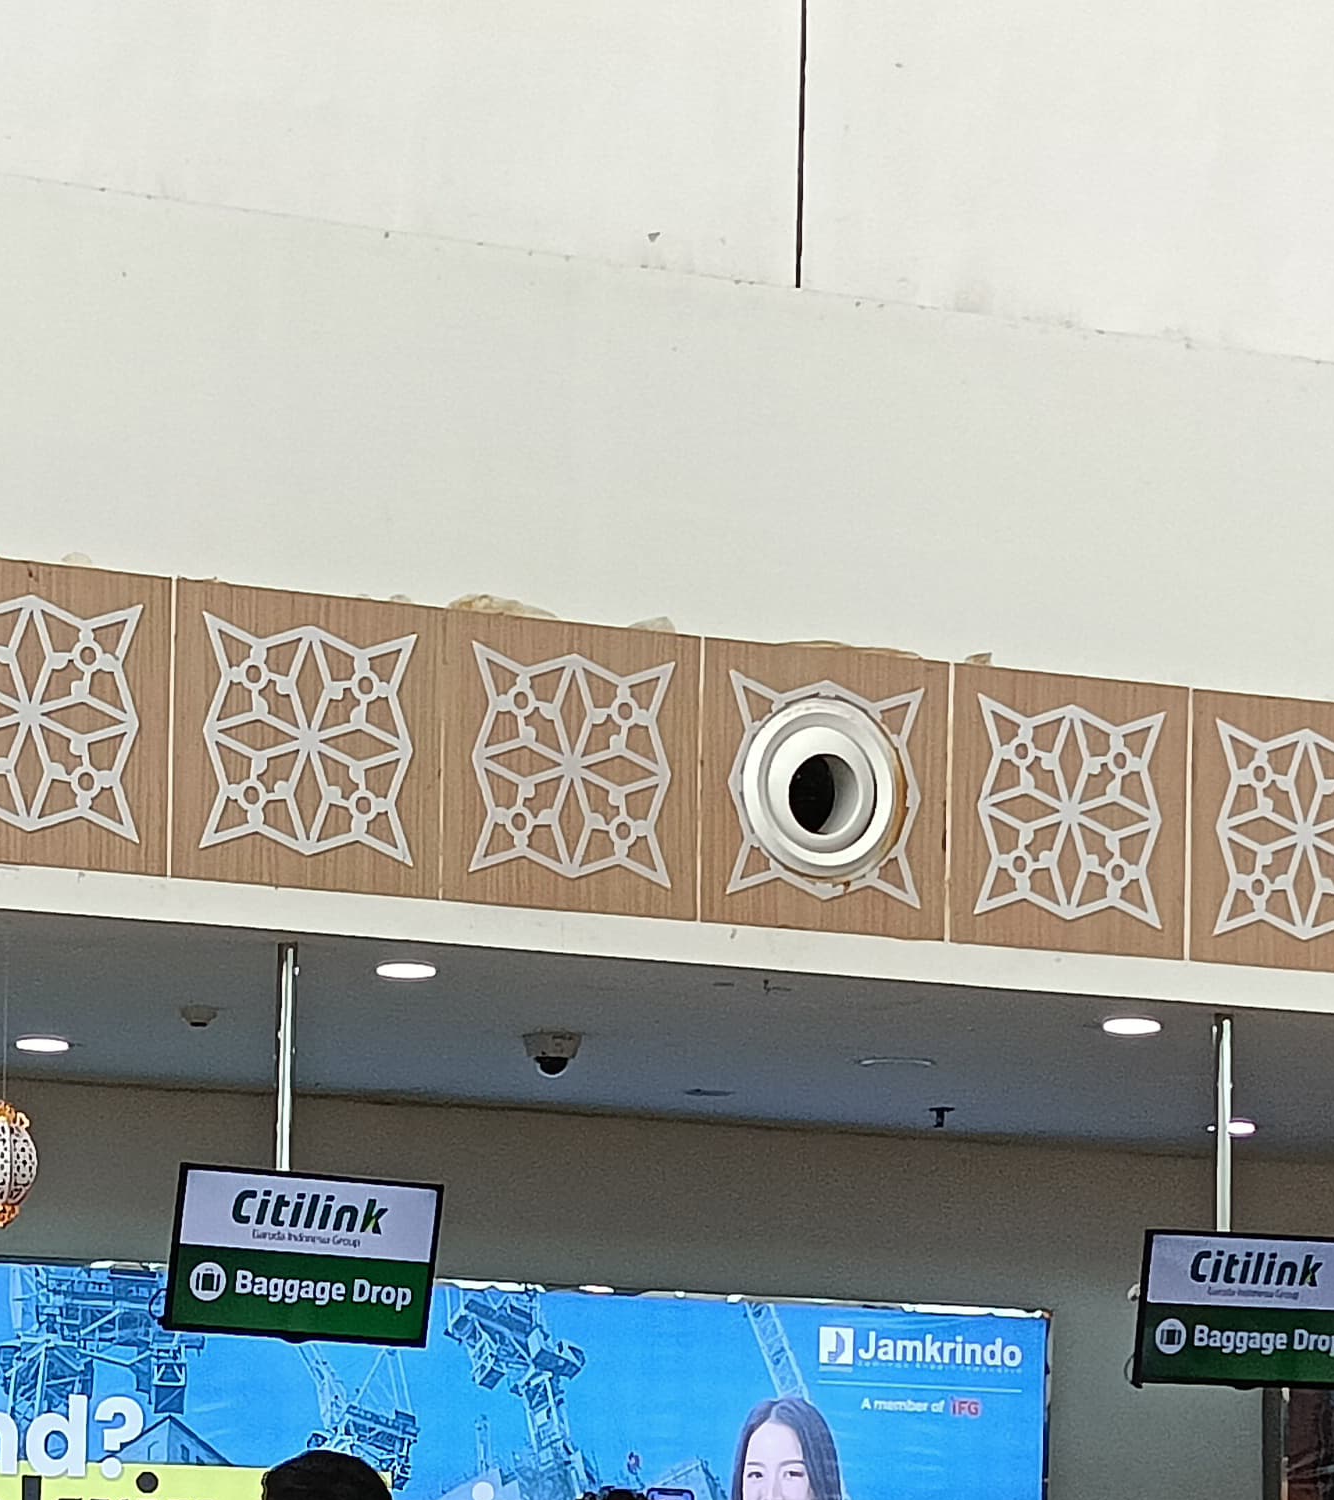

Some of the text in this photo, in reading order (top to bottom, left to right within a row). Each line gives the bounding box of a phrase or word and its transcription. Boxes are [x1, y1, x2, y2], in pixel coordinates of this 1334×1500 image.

[231, 1189, 389, 1236] Citilink
[1189, 1249, 1324, 1289] Citilink
[234, 1269, 413, 1312] Baggage Drop
[858, 1331, 1023, 1368] Jamkrindo
[1193, 1324, 1288, 1355] Baggage
